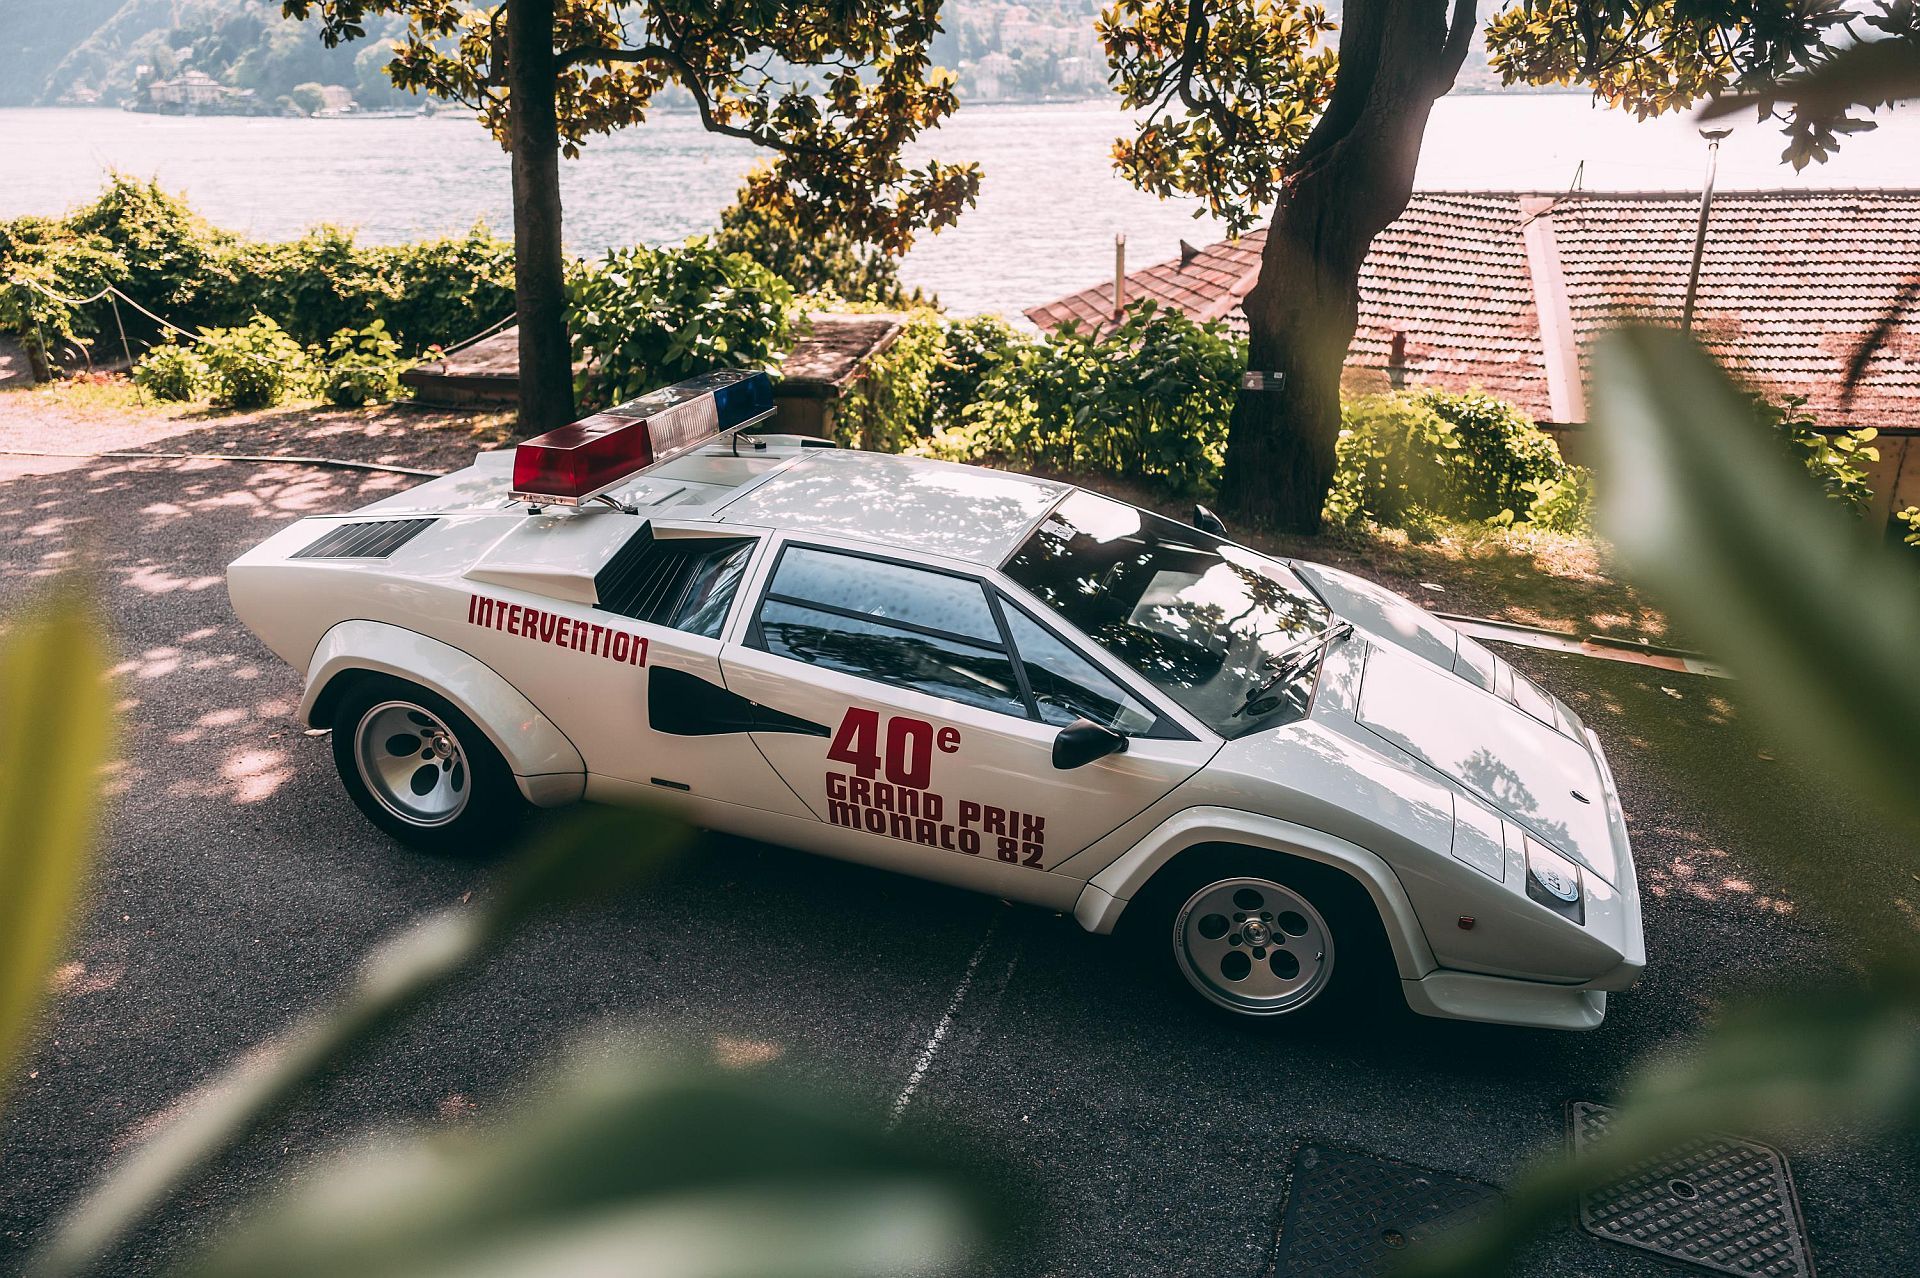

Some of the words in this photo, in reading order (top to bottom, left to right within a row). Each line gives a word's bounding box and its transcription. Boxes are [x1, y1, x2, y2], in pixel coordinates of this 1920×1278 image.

[468, 594, 648, 668] INTERVENTION
[825, 772, 944, 823] GRAND
[958, 800, 1046, 846] PRIX
[827, 799, 981, 856] MONACO
[997, 836, 1044, 869] 82
